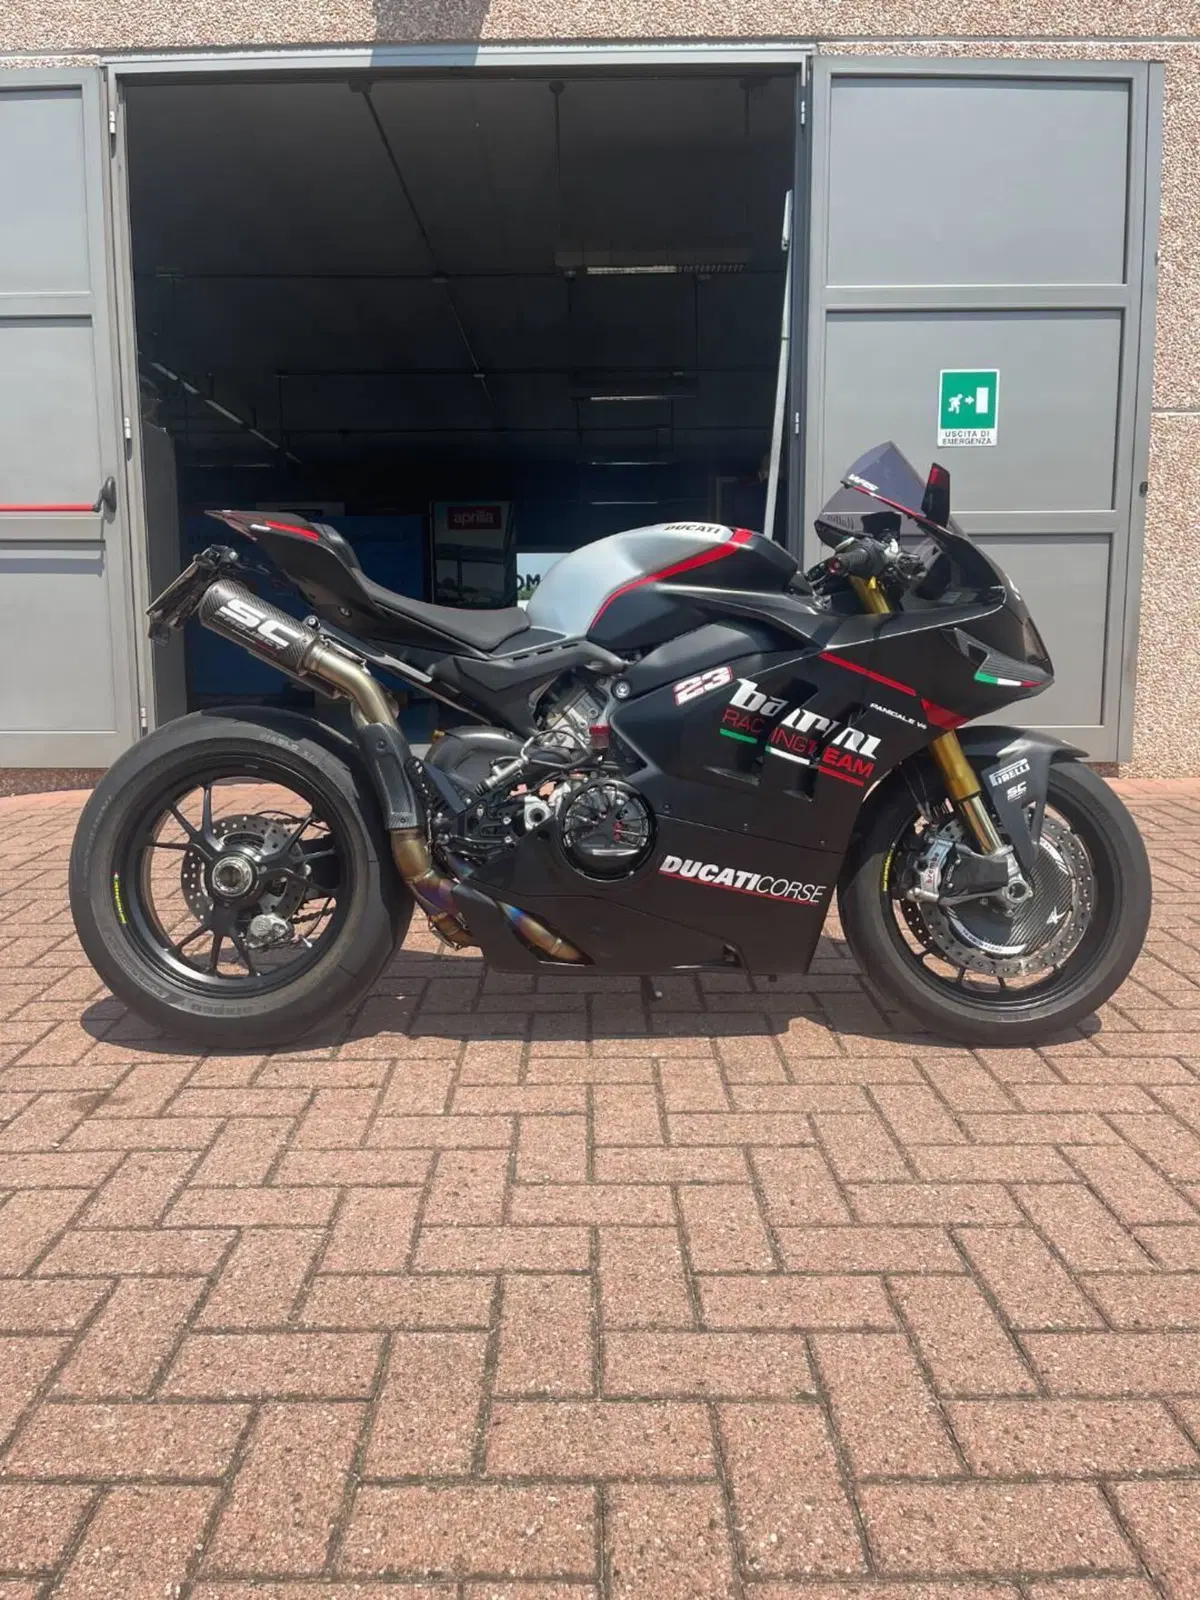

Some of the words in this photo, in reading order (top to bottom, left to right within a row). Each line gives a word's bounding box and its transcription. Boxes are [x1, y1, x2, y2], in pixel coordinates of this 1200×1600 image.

[945, 430, 977, 438] USCITA
[980, 430, 990, 438] DI
[453, 509, 494, 526] aprilia
[664, 524, 721, 534] DUCATI
[214, 610, 286, 650] PROJECT
[219, 599, 304, 648] SC
[672, 666, 733, 706] 23
[989, 758, 1030, 787] PIRELLI
